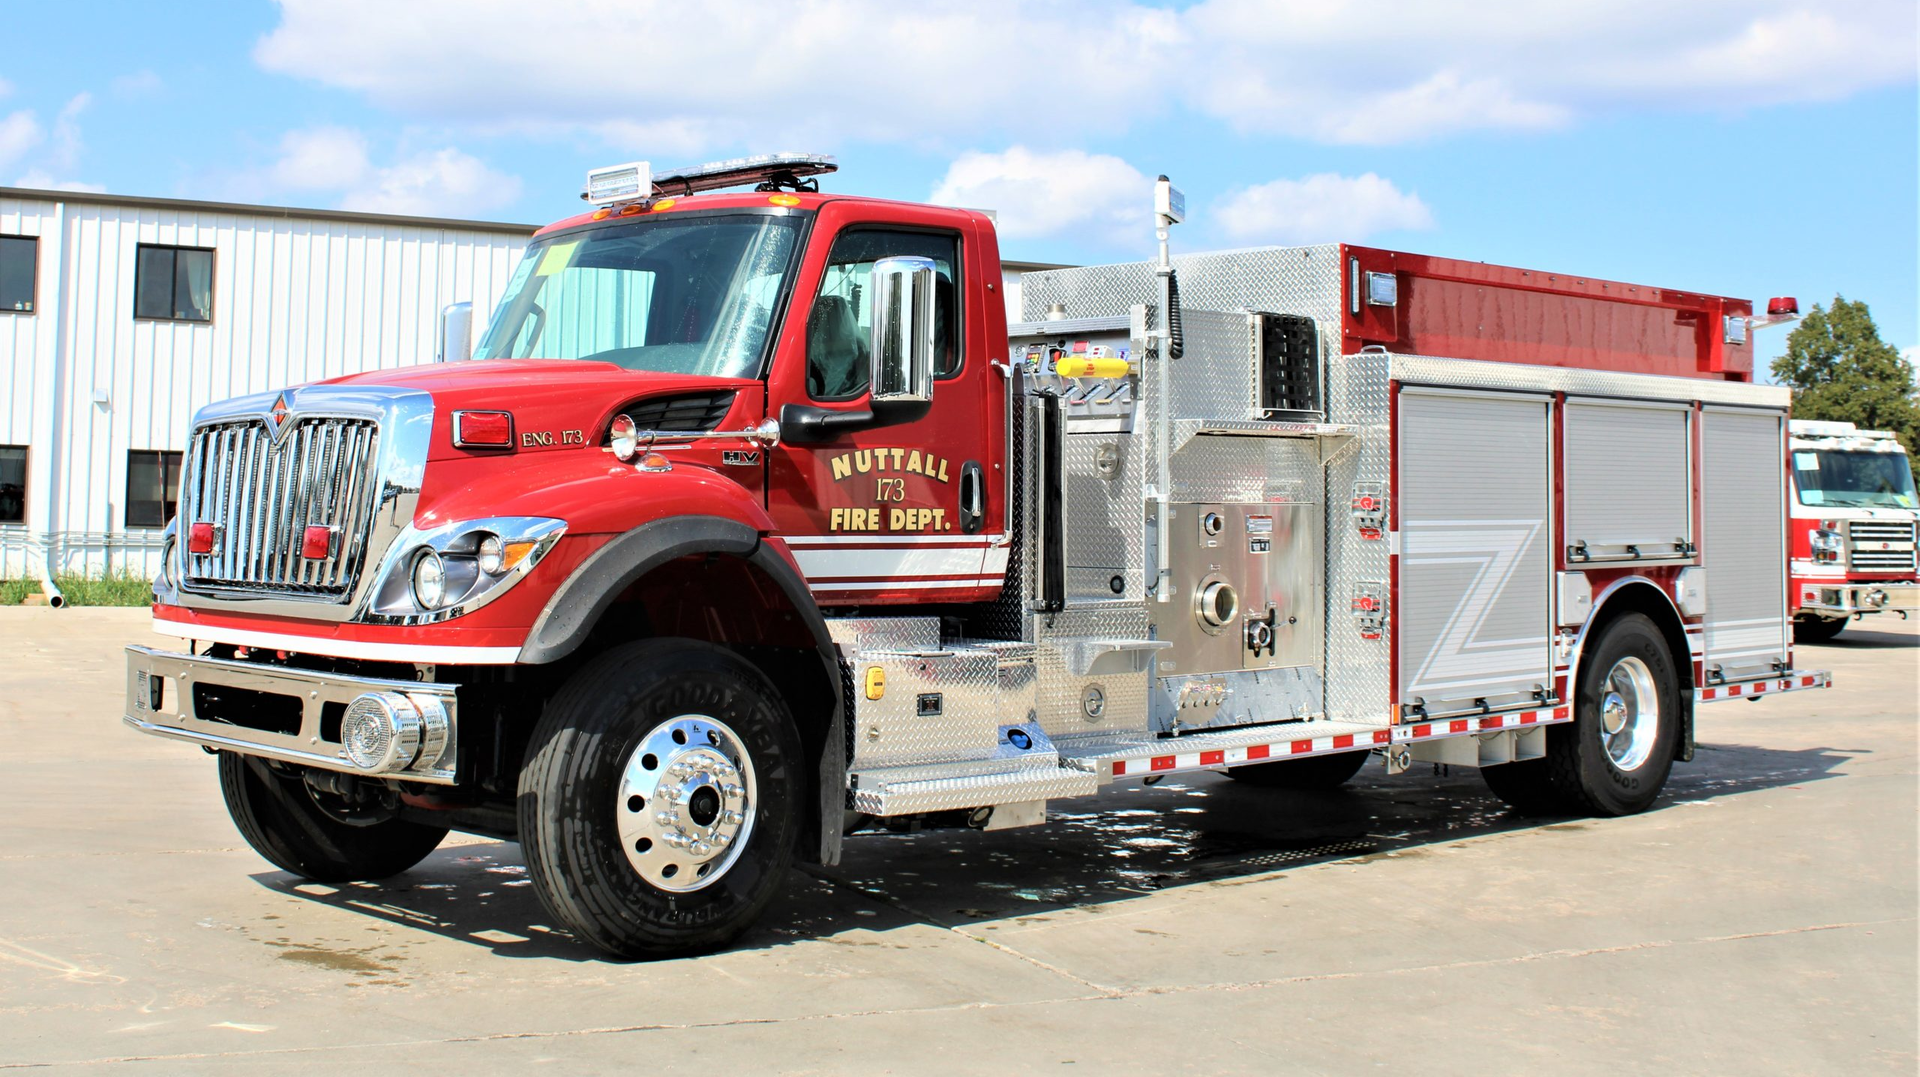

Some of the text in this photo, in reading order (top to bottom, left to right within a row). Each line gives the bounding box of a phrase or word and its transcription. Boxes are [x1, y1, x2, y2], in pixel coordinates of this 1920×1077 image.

[521, 429, 583, 447] ENG. 173
[722, 450, 760, 465] HV
[830, 447, 950, 483] NUTTALL
[875, 477, 906, 503] 173
[829, 507, 952, 532] FIRE DEPT.
